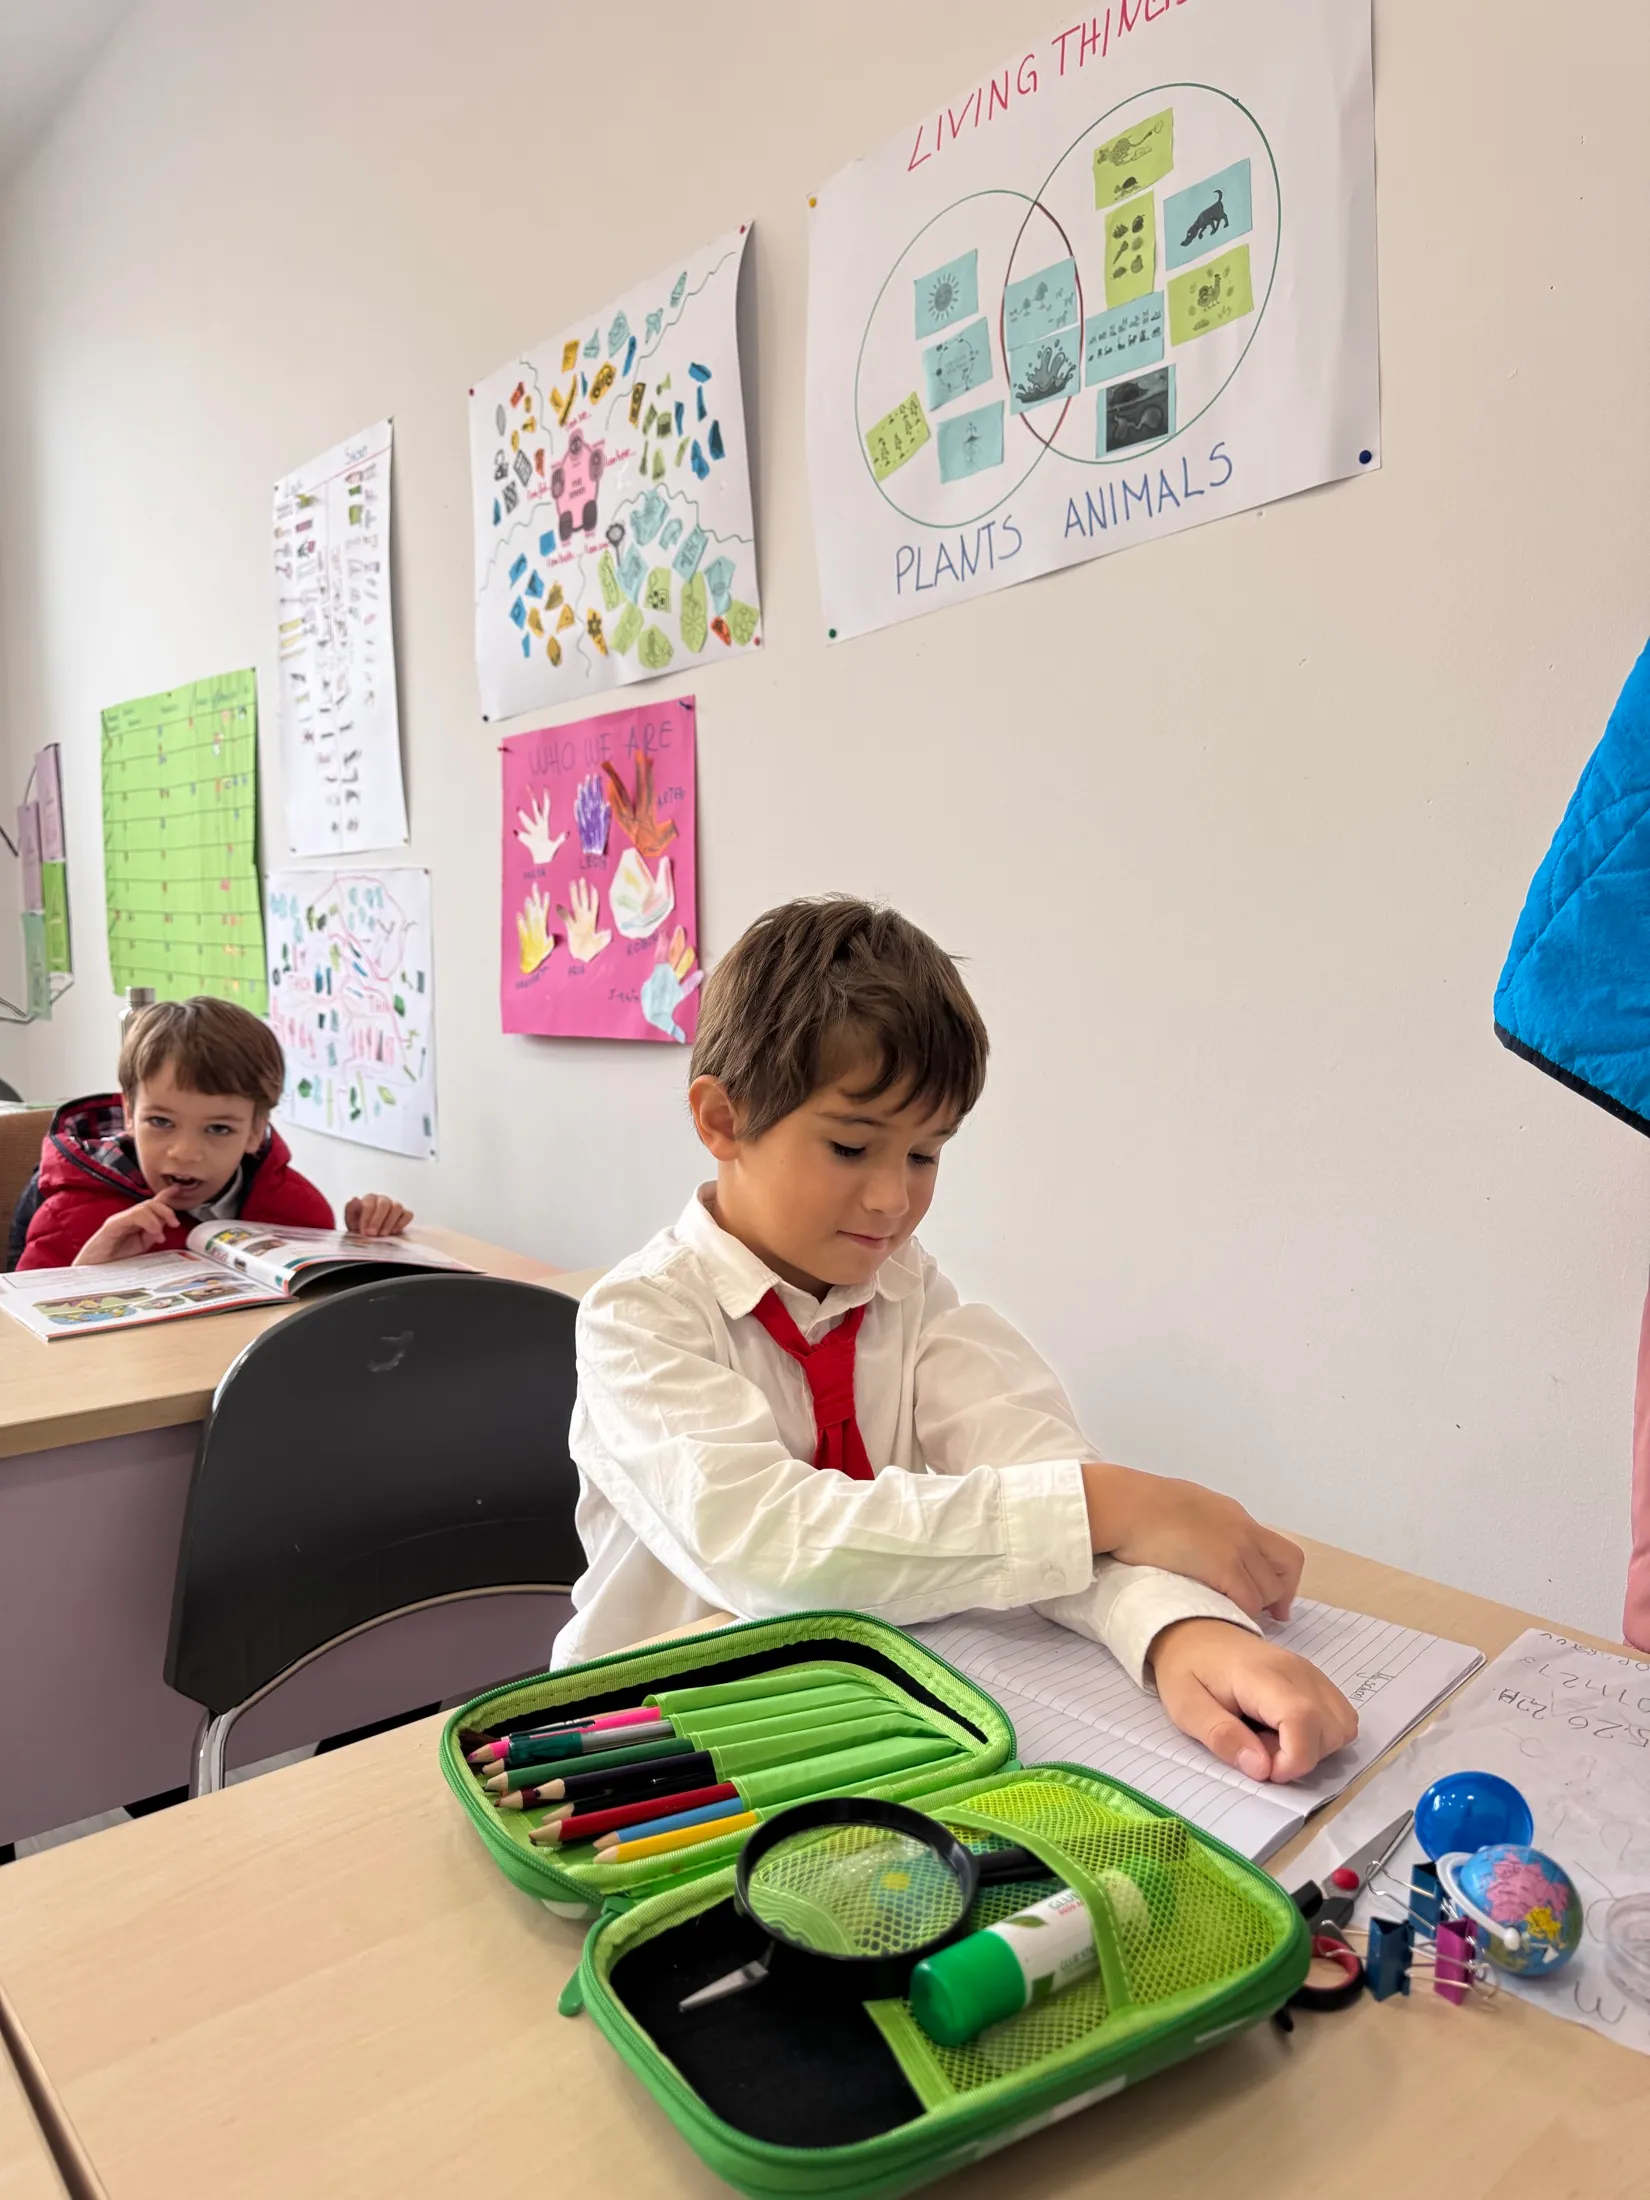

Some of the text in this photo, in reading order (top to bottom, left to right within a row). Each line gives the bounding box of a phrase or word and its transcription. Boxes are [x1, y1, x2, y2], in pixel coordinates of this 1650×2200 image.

[908, 54, 1037, 171] LIVING
[896, 442, 1233, 594] PLANTS ANIMALS
[528, 720, 674, 777] WHO WE ARE
